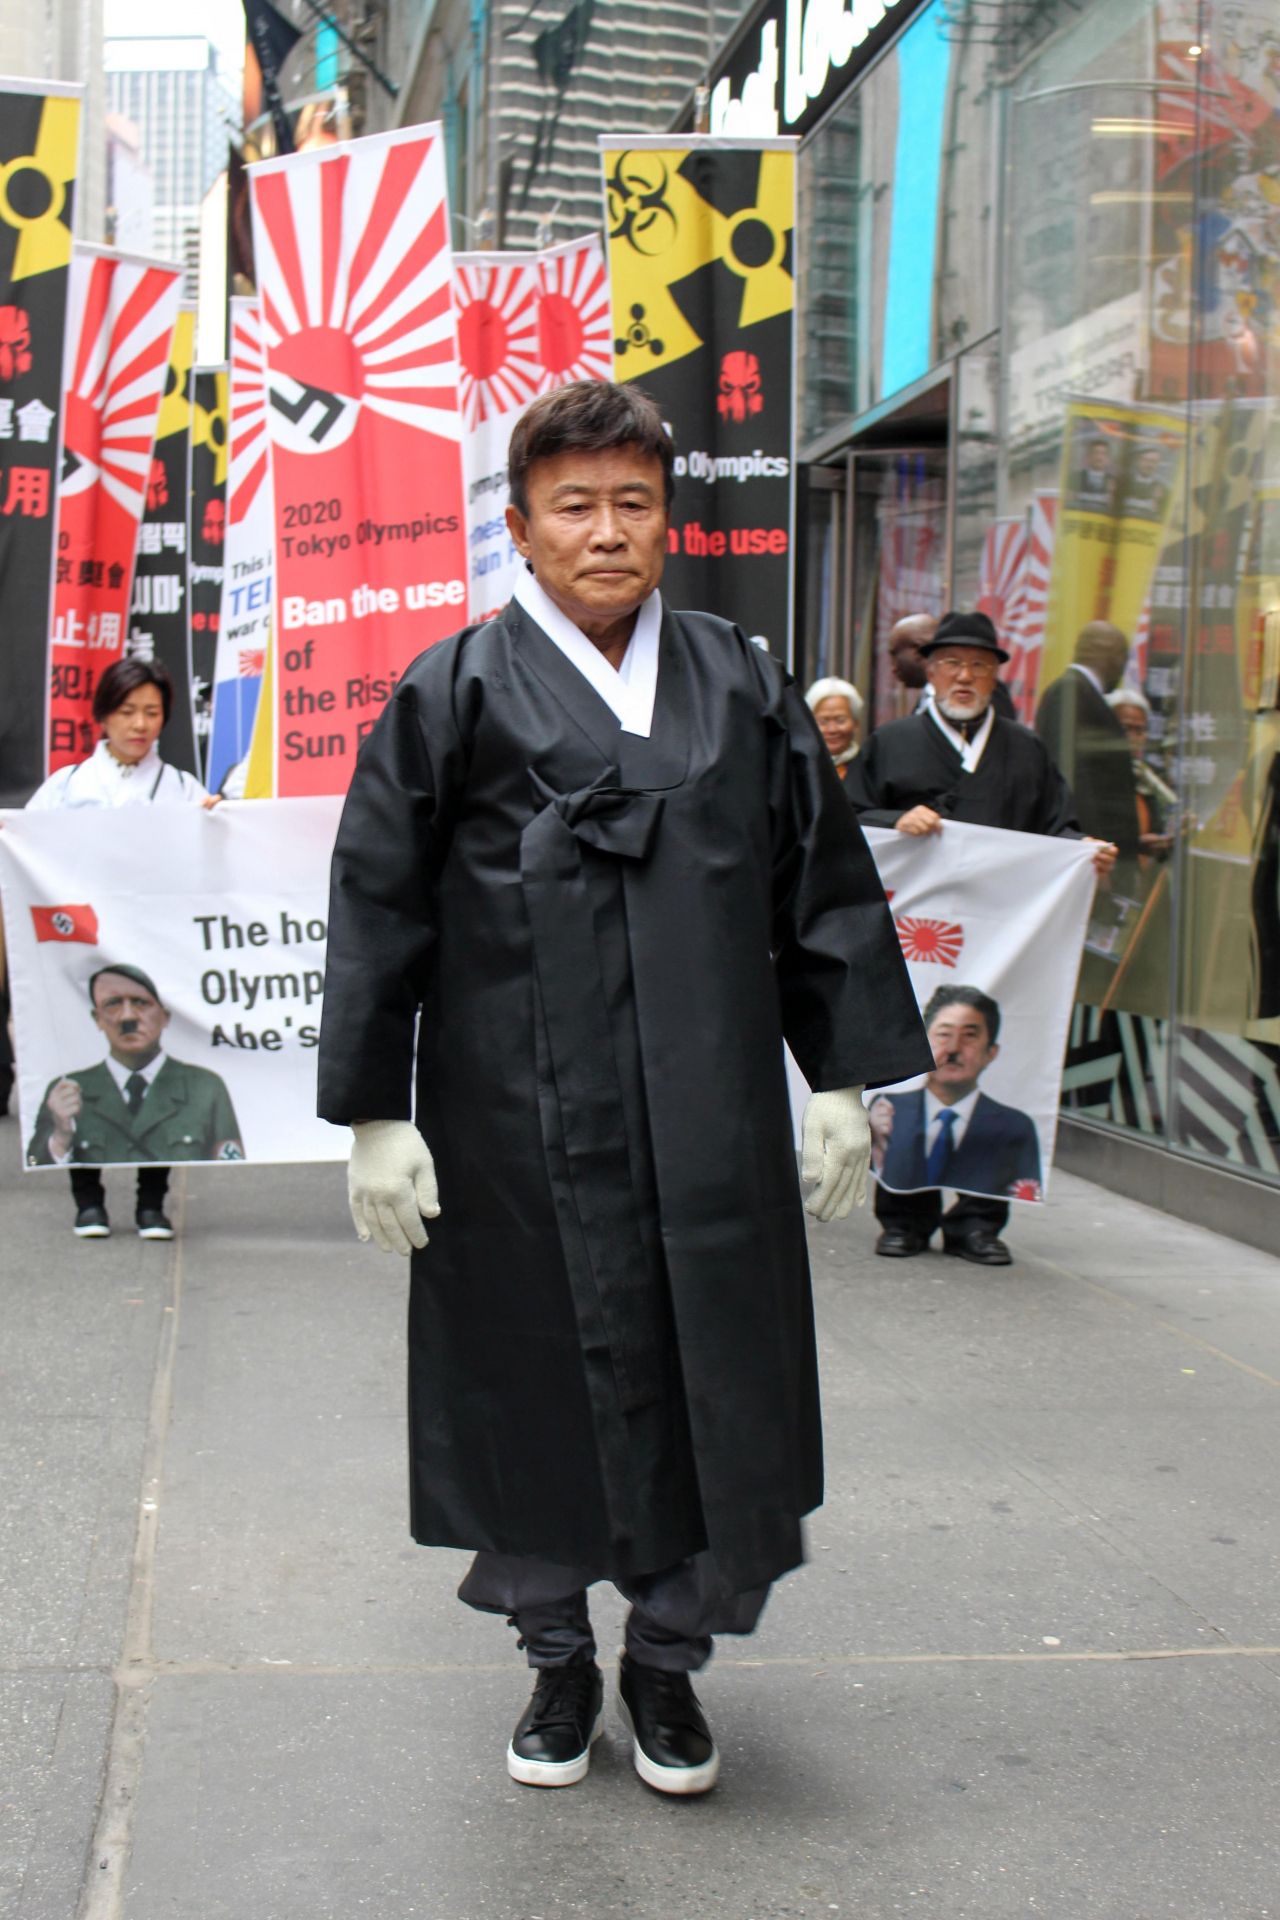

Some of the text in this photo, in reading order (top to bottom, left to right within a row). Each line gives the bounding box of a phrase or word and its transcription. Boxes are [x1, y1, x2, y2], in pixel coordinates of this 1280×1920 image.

[688, 449, 789, 483] Olympics
[0, 465, 50, 518] 用
[283, 498, 342, 528] 2020
[136, 522, 186, 555] 림픽
[282, 512, 459, 558] Tokyo Olympics
[683, 521, 727, 556] the
[730, 528, 788, 555] use
[232, 556, 263, 580] This
[281, 579, 466, 629] Ban the use
[227, 618, 258, 641] war
[285, 640, 315, 672] of
[285, 687, 335, 716] the
[285, 731, 345, 761] Sun
[193, 914, 268, 951] The
[200, 968, 323, 1009] Olymp
